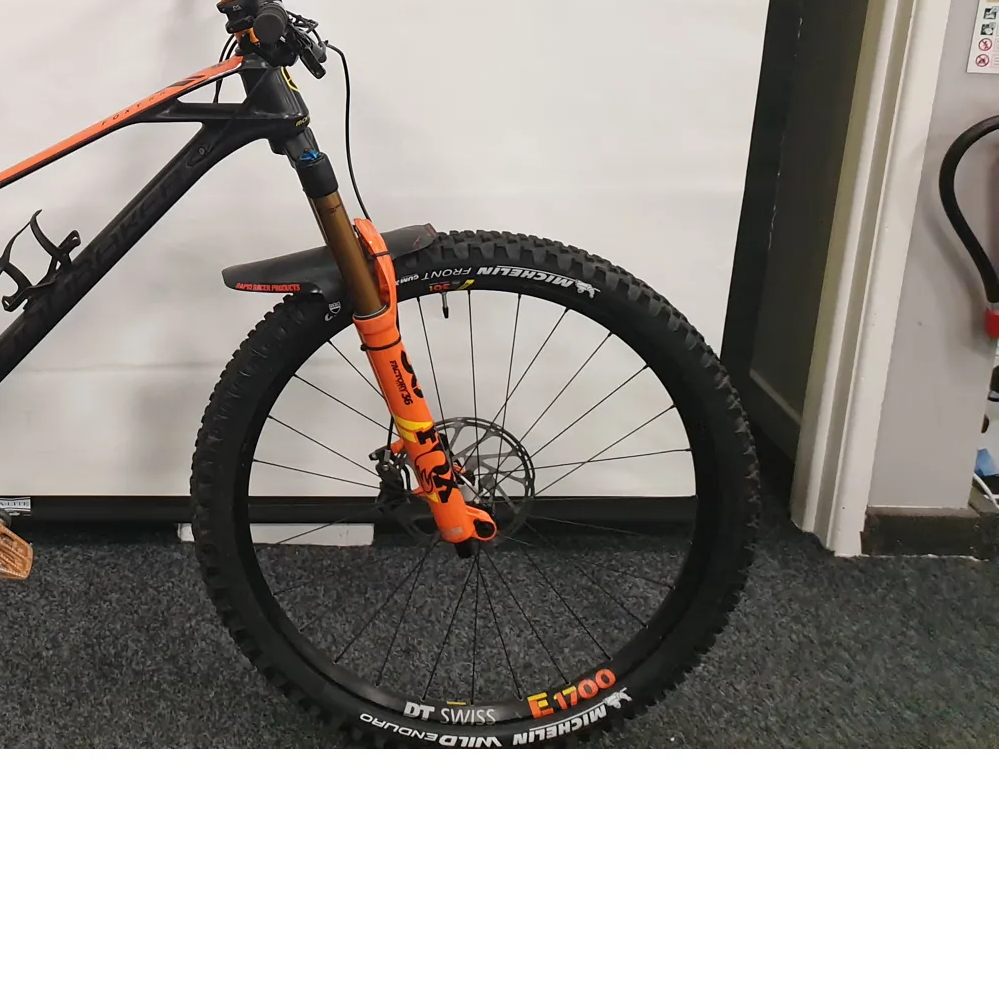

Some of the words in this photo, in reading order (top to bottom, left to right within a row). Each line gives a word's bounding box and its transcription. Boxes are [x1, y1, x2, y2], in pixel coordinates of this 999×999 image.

[421, 267, 472, 281] FRONT
[476, 264, 575, 288] MICHELIN
[553, 668, 617, 710] 1700
[403, 701, 436, 721] DT
[440, 707, 497, 726] SWISS
[512, 703, 608, 746] MICHELIN
